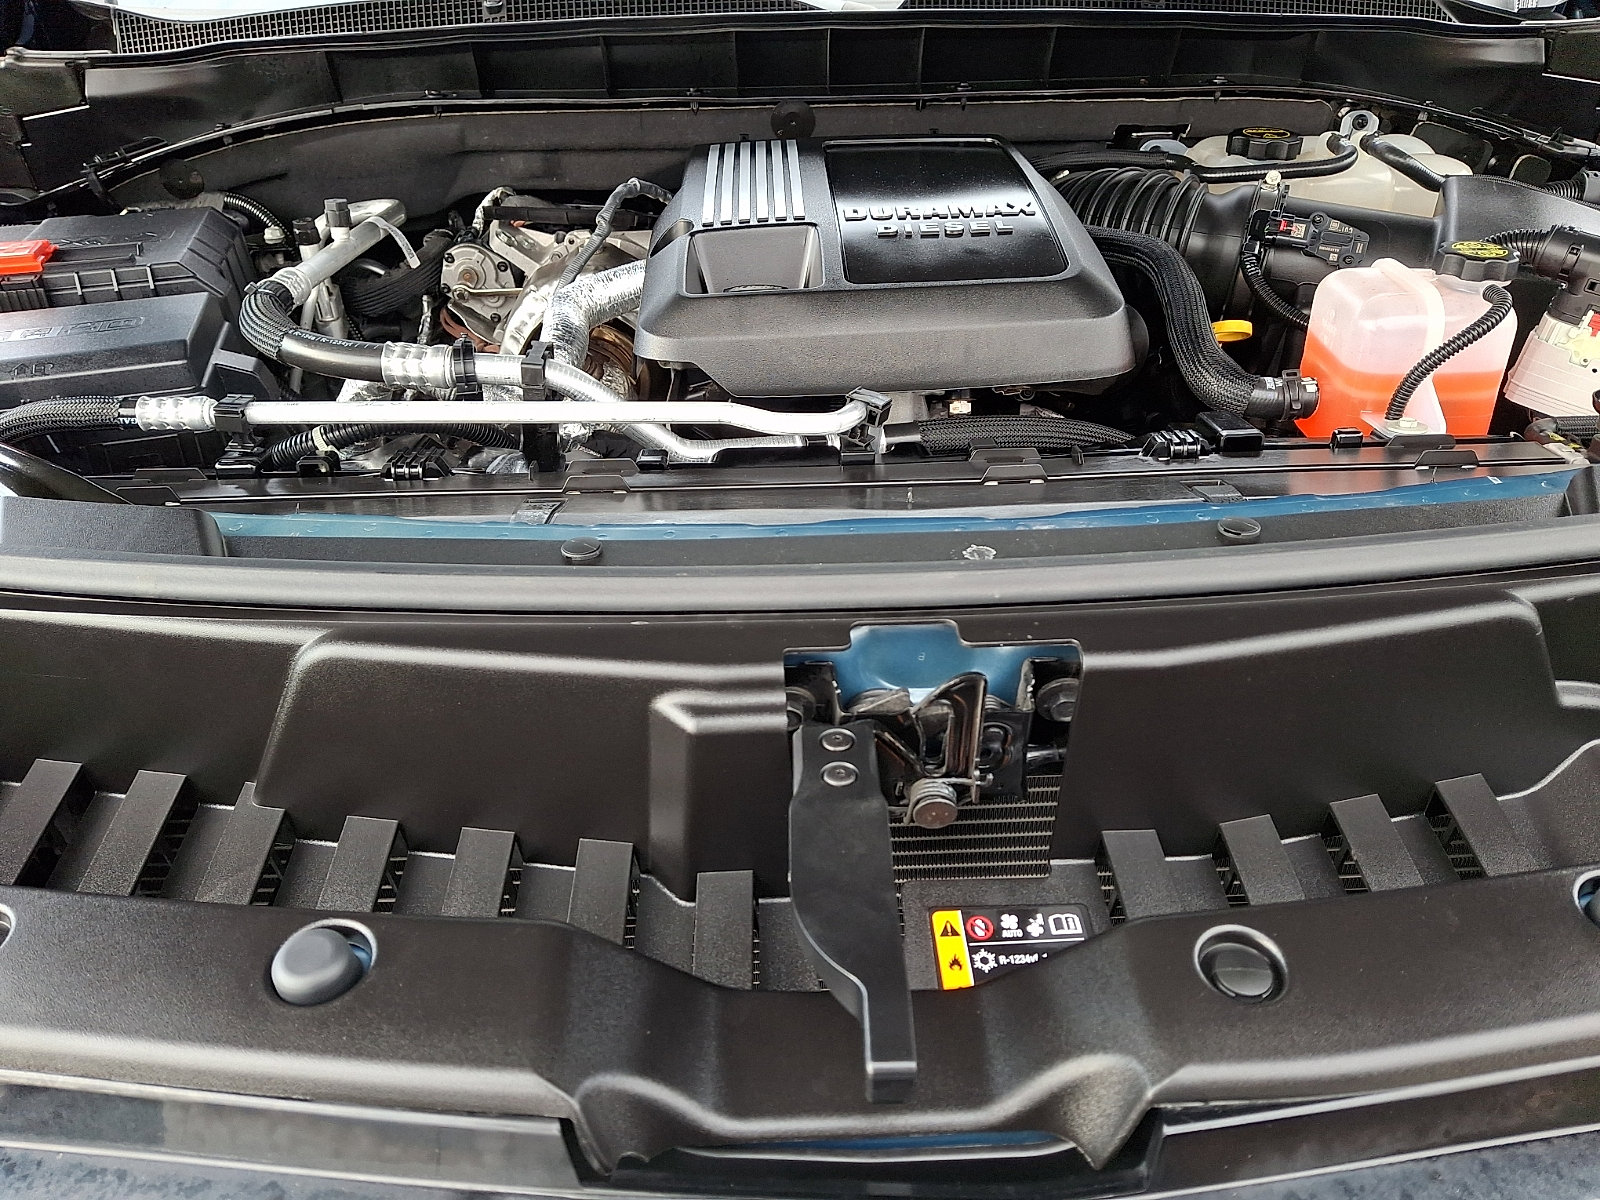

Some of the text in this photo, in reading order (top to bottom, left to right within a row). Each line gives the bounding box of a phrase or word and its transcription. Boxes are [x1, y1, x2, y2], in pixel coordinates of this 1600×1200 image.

[842, 202, 1036, 221] DURAMAX
[875, 221, 1014, 238] DIESEL
[1002, 929, 1024, 938] AUTO
